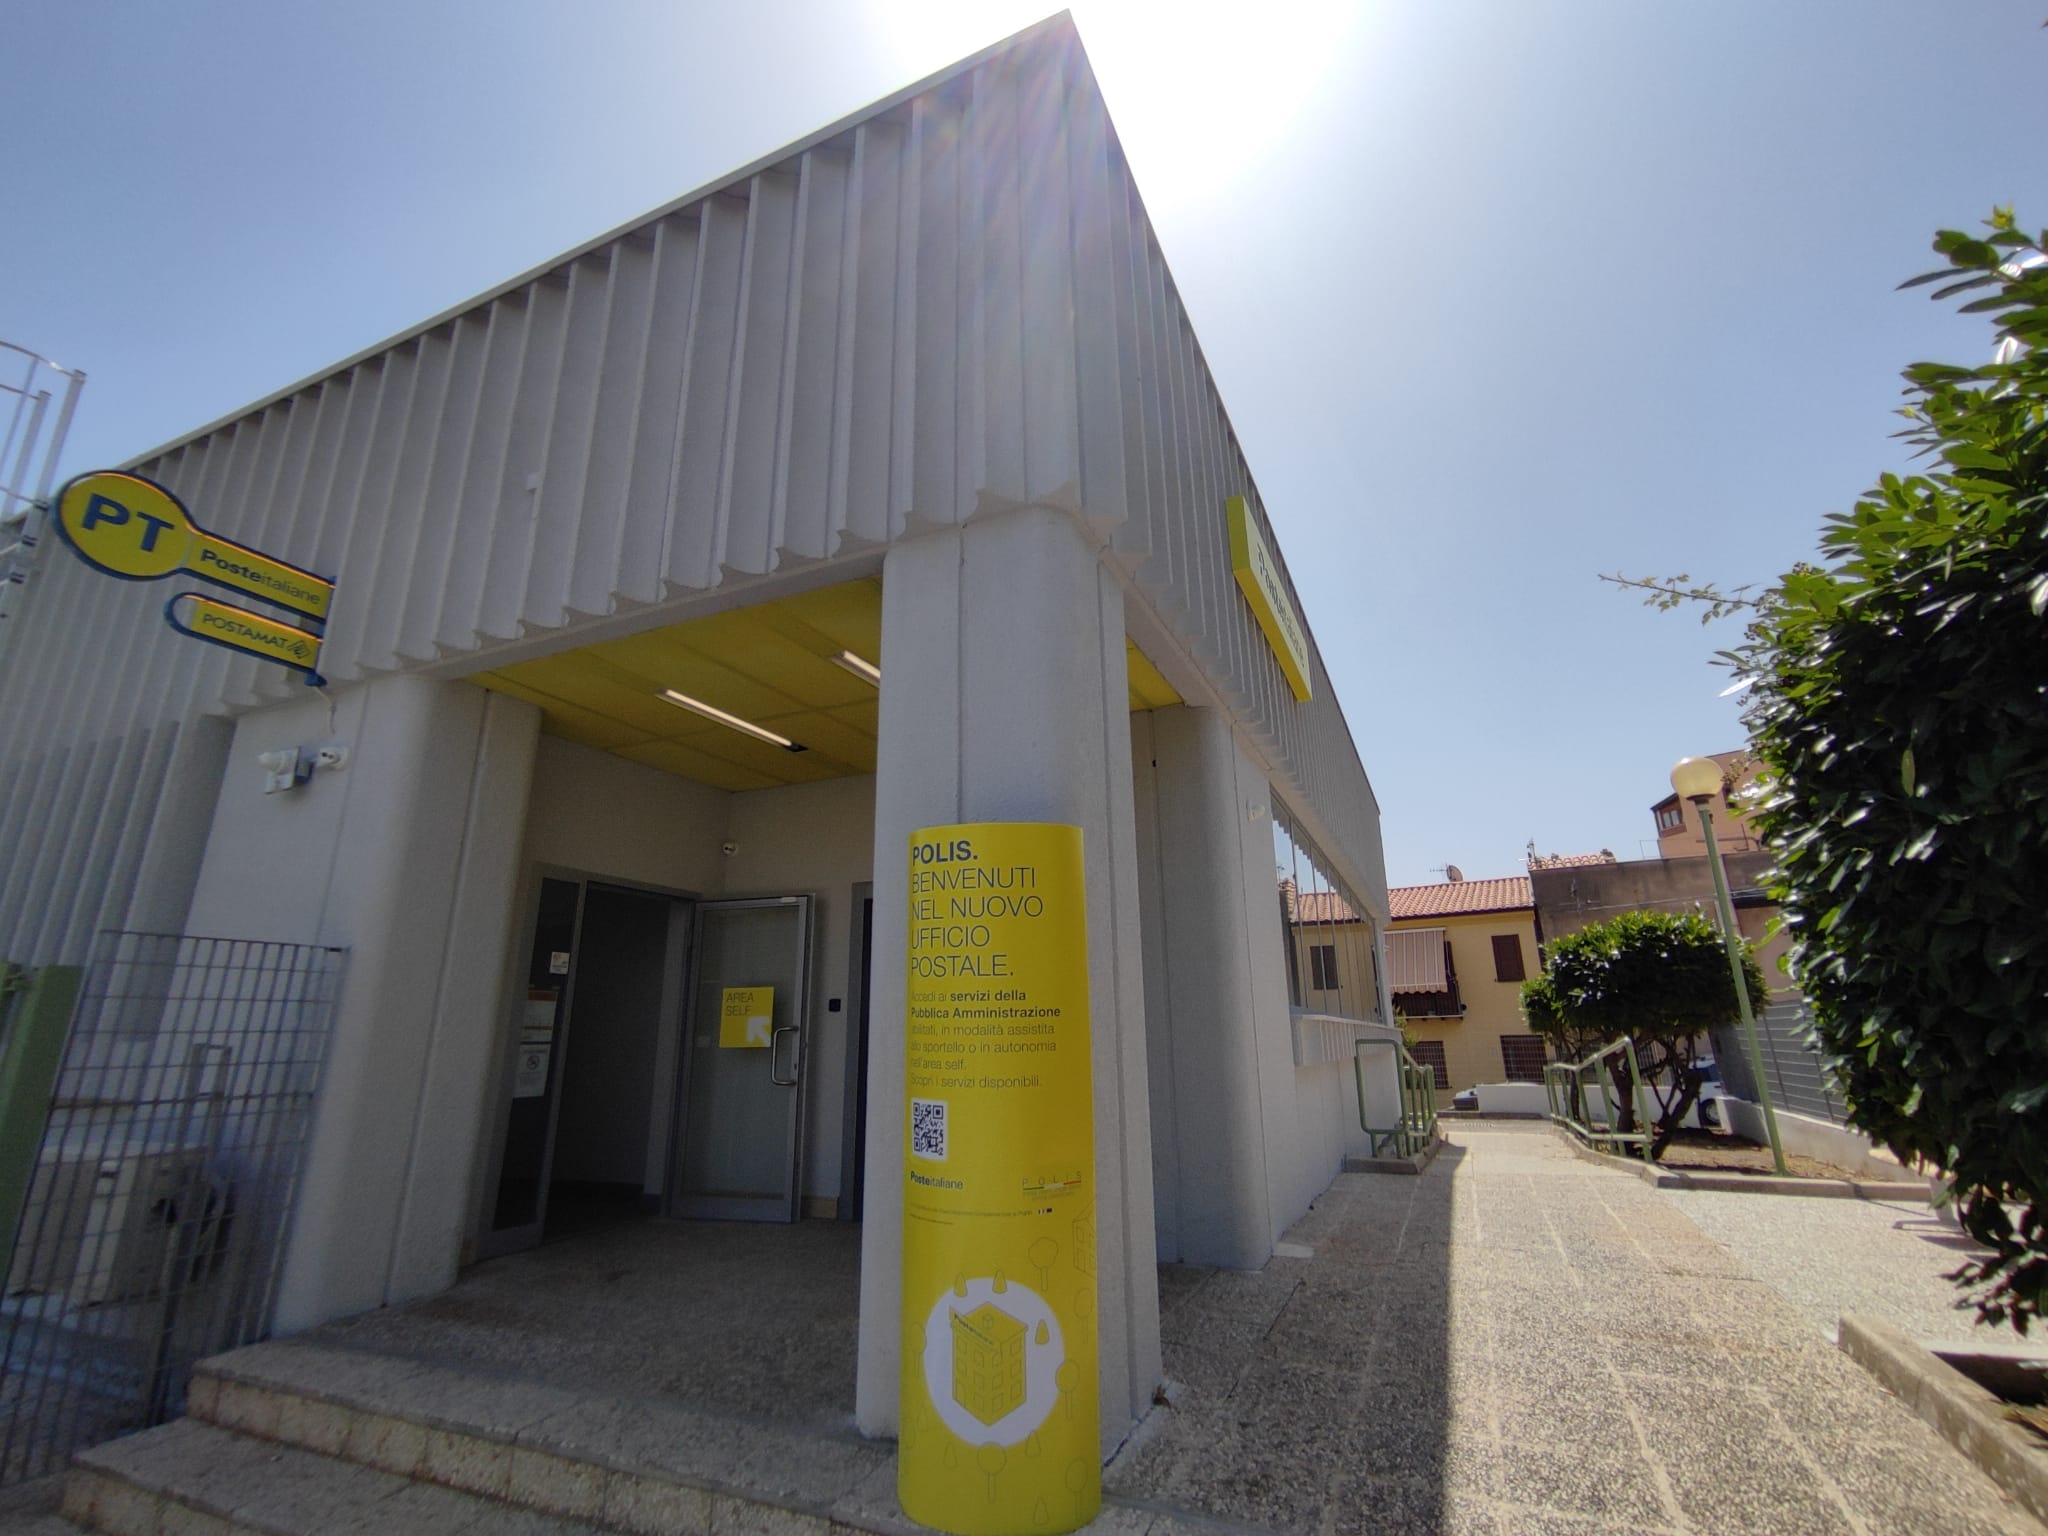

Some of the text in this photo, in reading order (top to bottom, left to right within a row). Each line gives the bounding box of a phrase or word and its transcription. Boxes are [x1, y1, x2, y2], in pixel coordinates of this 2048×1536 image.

[82, 493, 174, 552] PT
[200, 549, 321, 605] Posteitaliane
[202, 613, 288, 650] POSTAMAT
[913, 840, 978, 866] POLIS.
[912, 867, 1035, 893] BENVENUTI
[912, 895, 1043, 920] NEL NUOVO
[911, 925, 990, 949] UFFICIO
[911, 954, 1014, 977] POSTALE.
[727, 992, 754, 1003] AREA
[950, 990, 990, 1002] servizi
[995, 989, 1026, 1001] della
[725, 1005, 752, 1017] SELF
[911, 1006, 1061, 1019] Pubblica Amministrazione
[953, 1023, 1003, 1036] modalità
[1007, 1023, 1055, 1036] assistita
[922, 1040, 965, 1054] sportello
[981, 1040, 990, 1053] in
[994, 1040, 1056, 1053] autonomia
[941, 1075, 975, 1088] servizi
